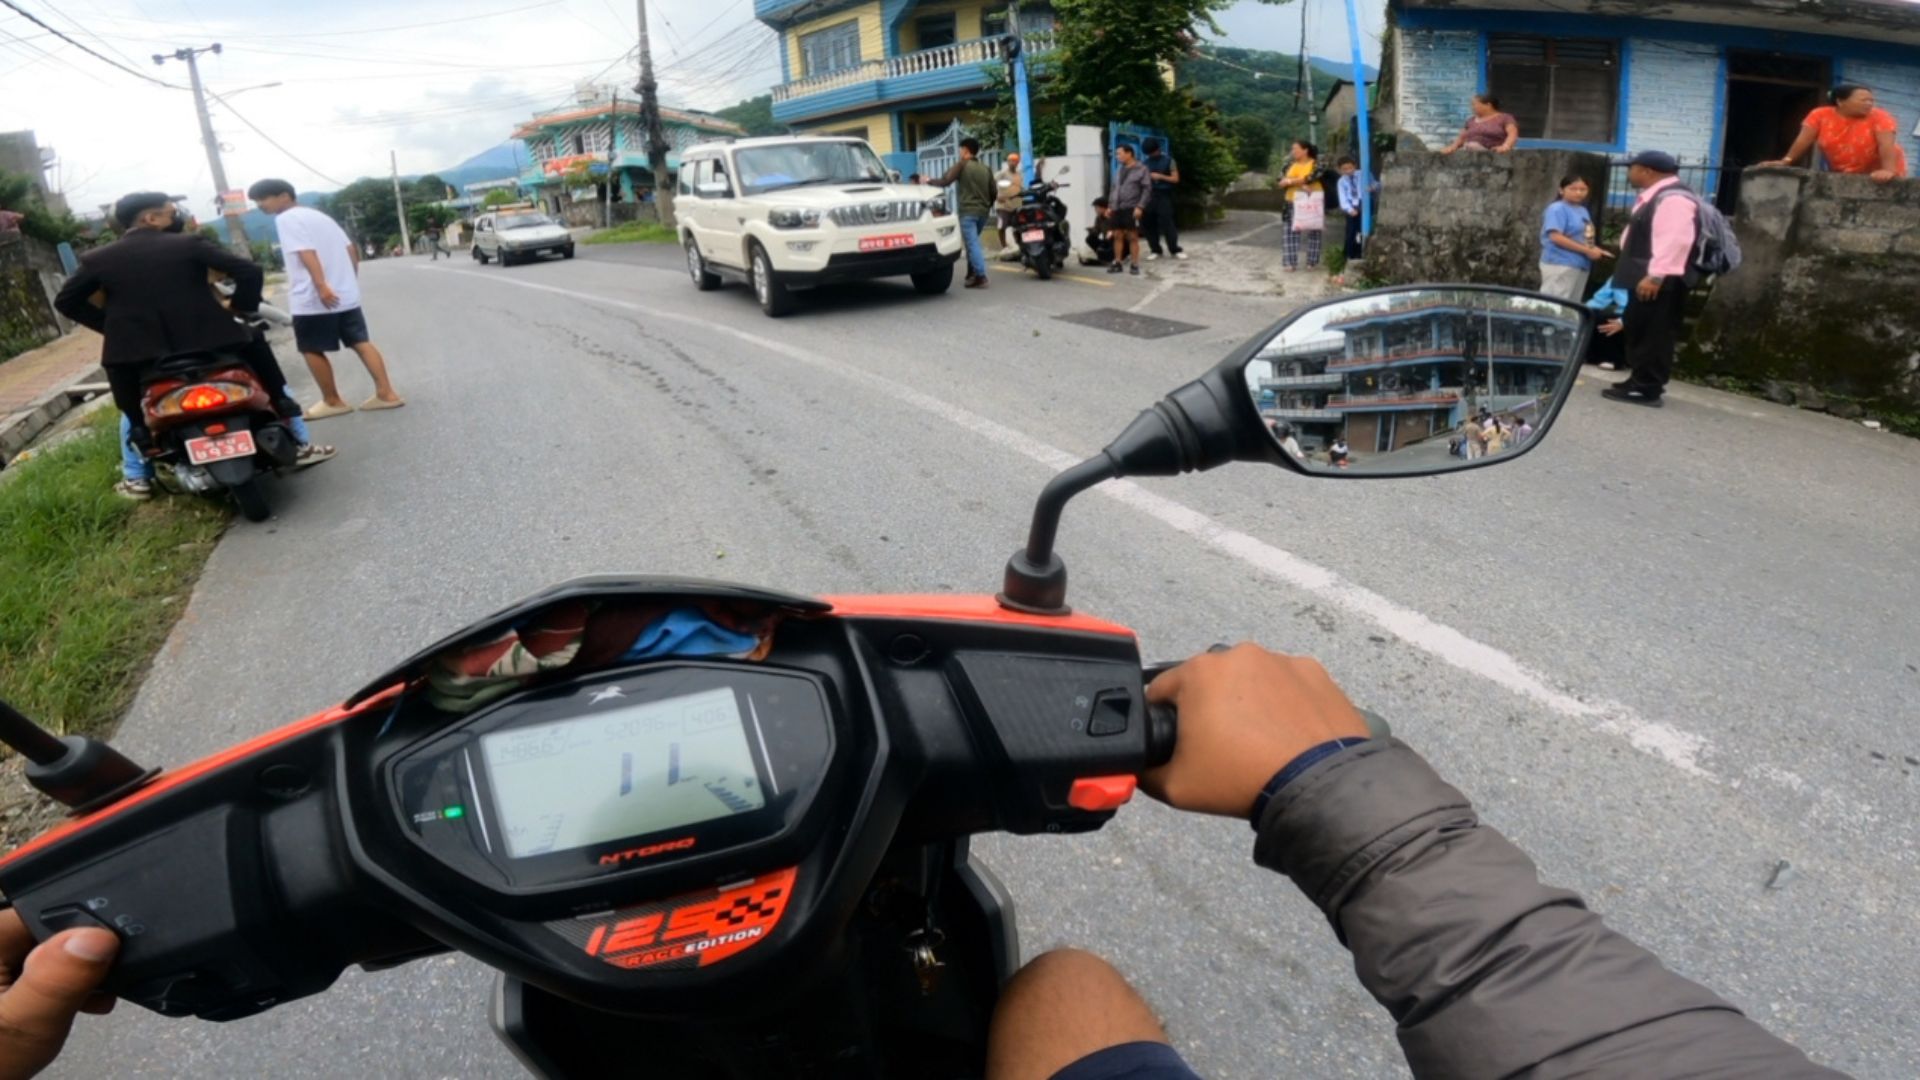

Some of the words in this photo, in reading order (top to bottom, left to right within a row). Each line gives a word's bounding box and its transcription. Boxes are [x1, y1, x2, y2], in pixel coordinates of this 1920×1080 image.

[600, 837, 696, 865] NTORQ
[586, 900, 718, 957] 125
[626, 945, 684, 967] RACE
[684, 927, 763, 954] EDITION
